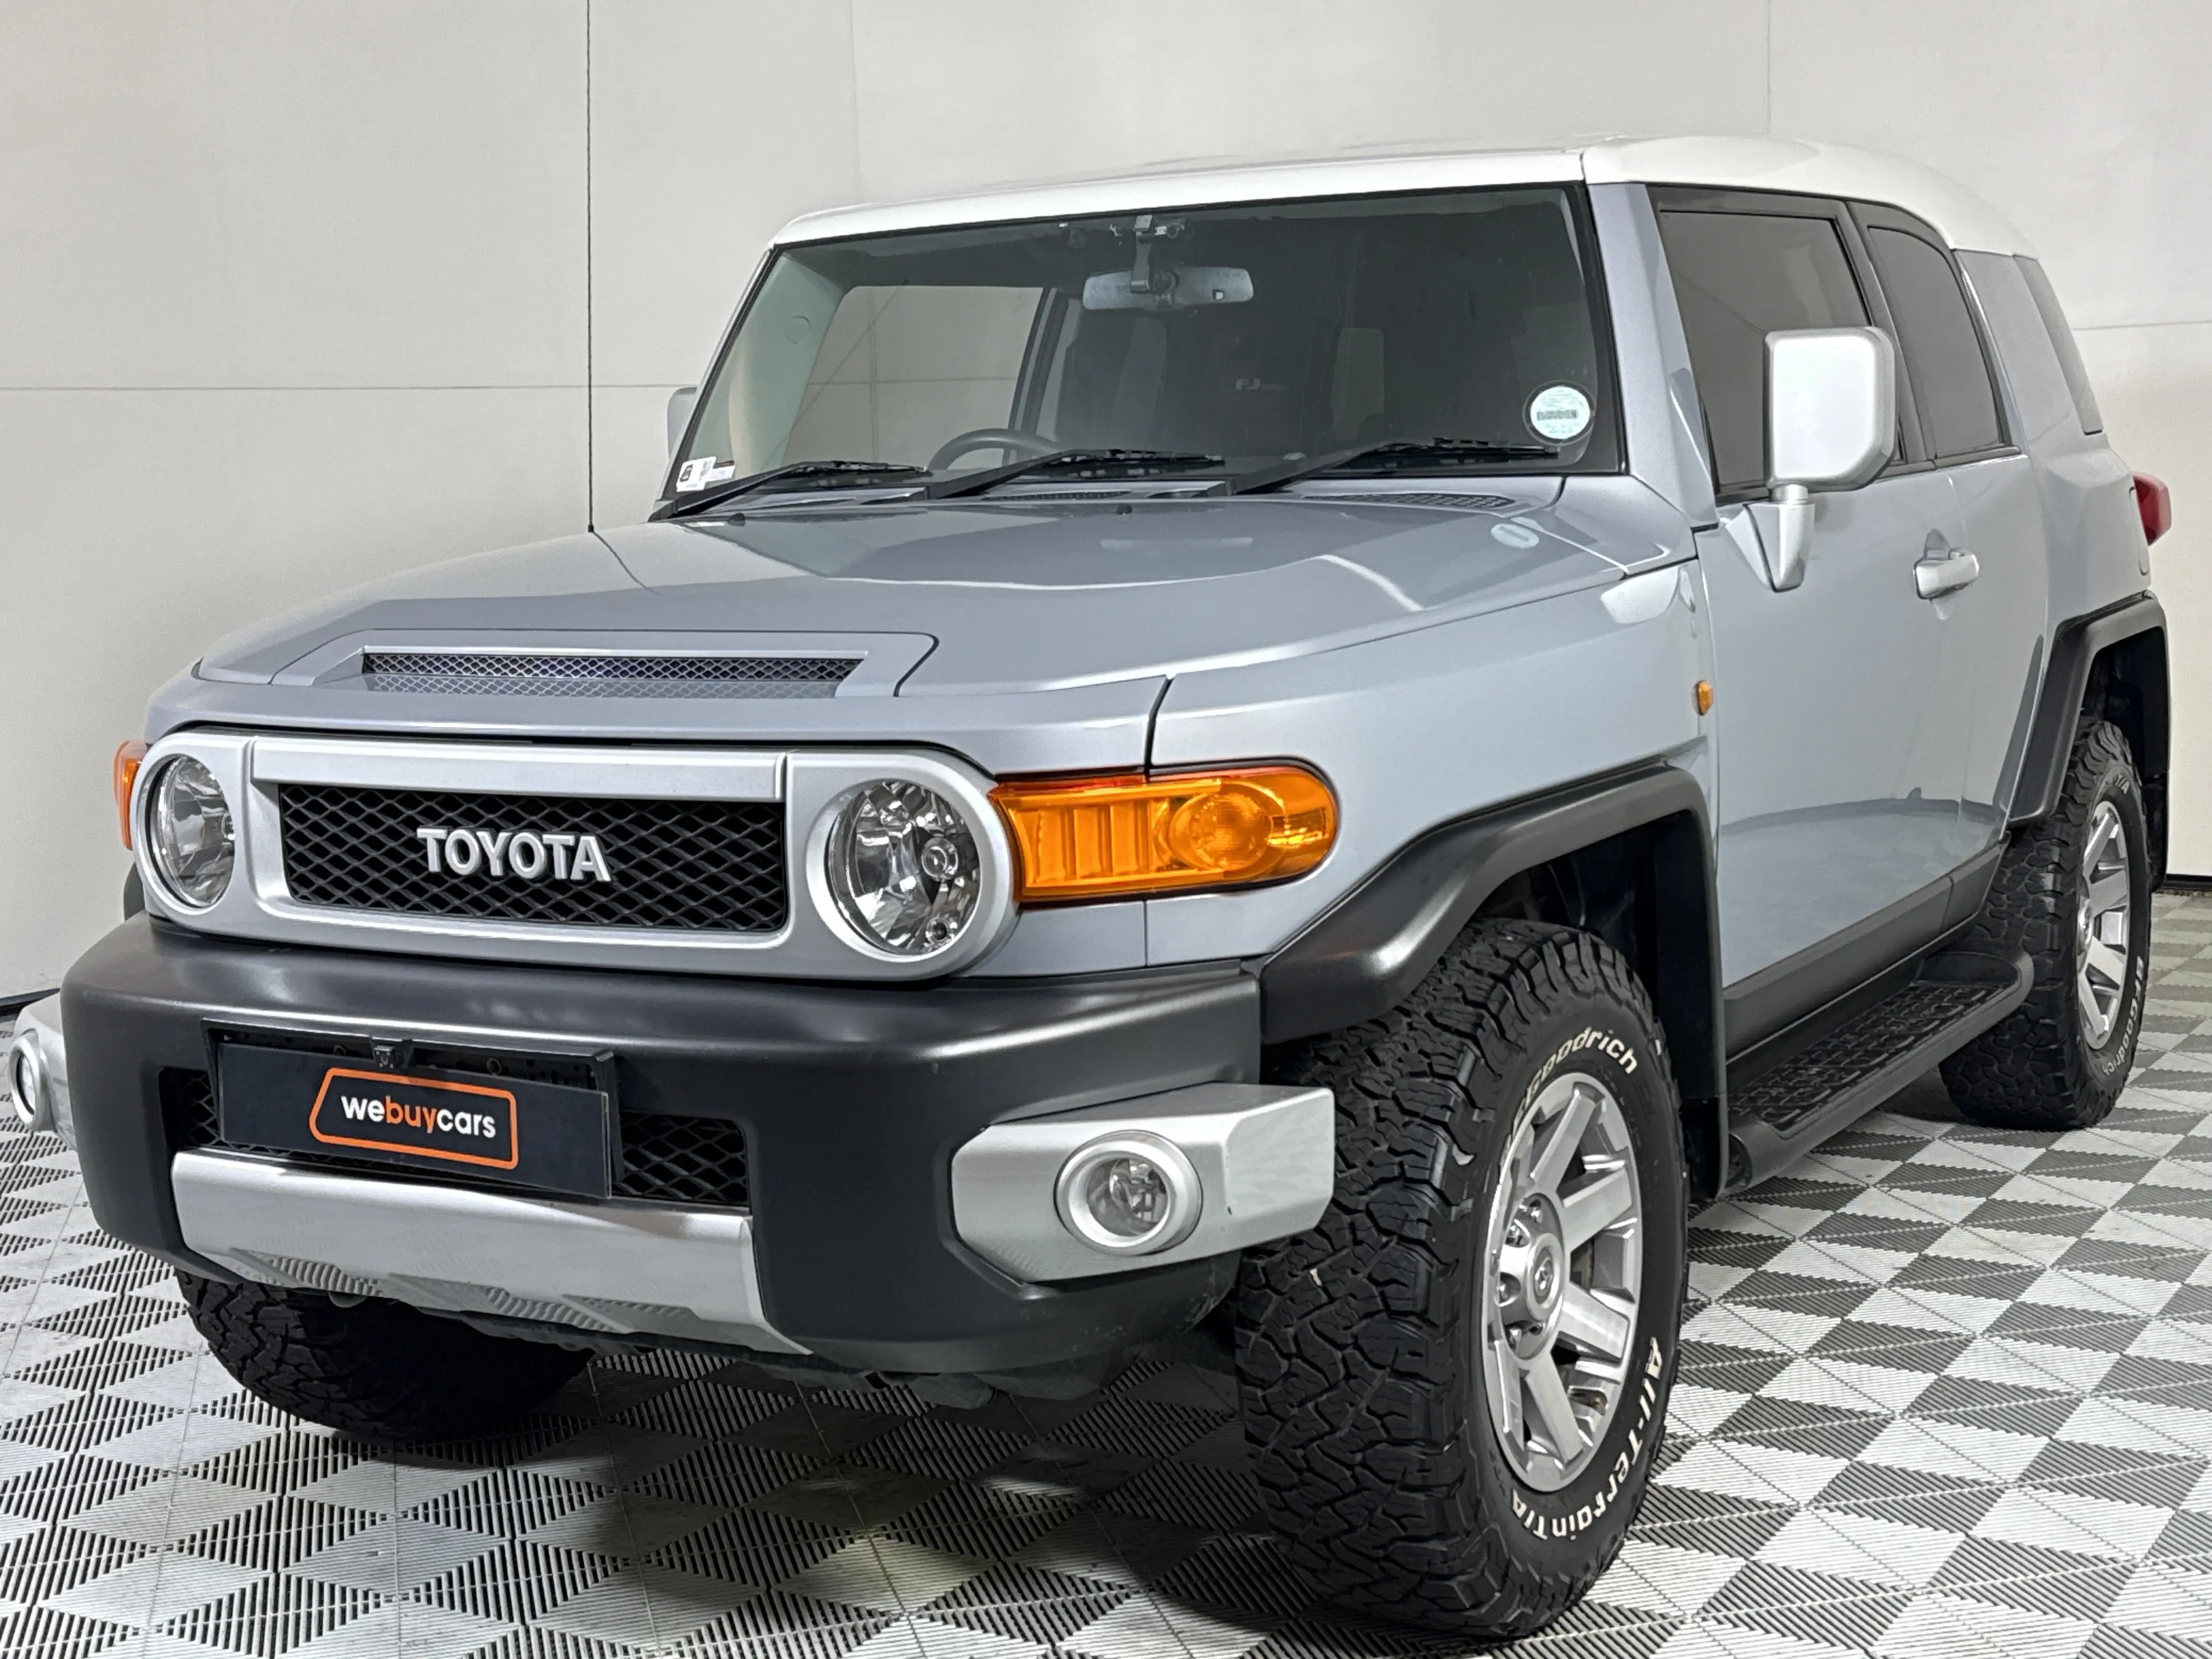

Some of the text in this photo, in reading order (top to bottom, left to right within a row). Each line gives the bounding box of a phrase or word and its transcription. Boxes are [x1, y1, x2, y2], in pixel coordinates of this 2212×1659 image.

[416, 825, 611, 882] TOYOTA
[341, 1095, 496, 1138] webuycars
[1513, 1336, 1662, 1540] All-Terrain T/A
